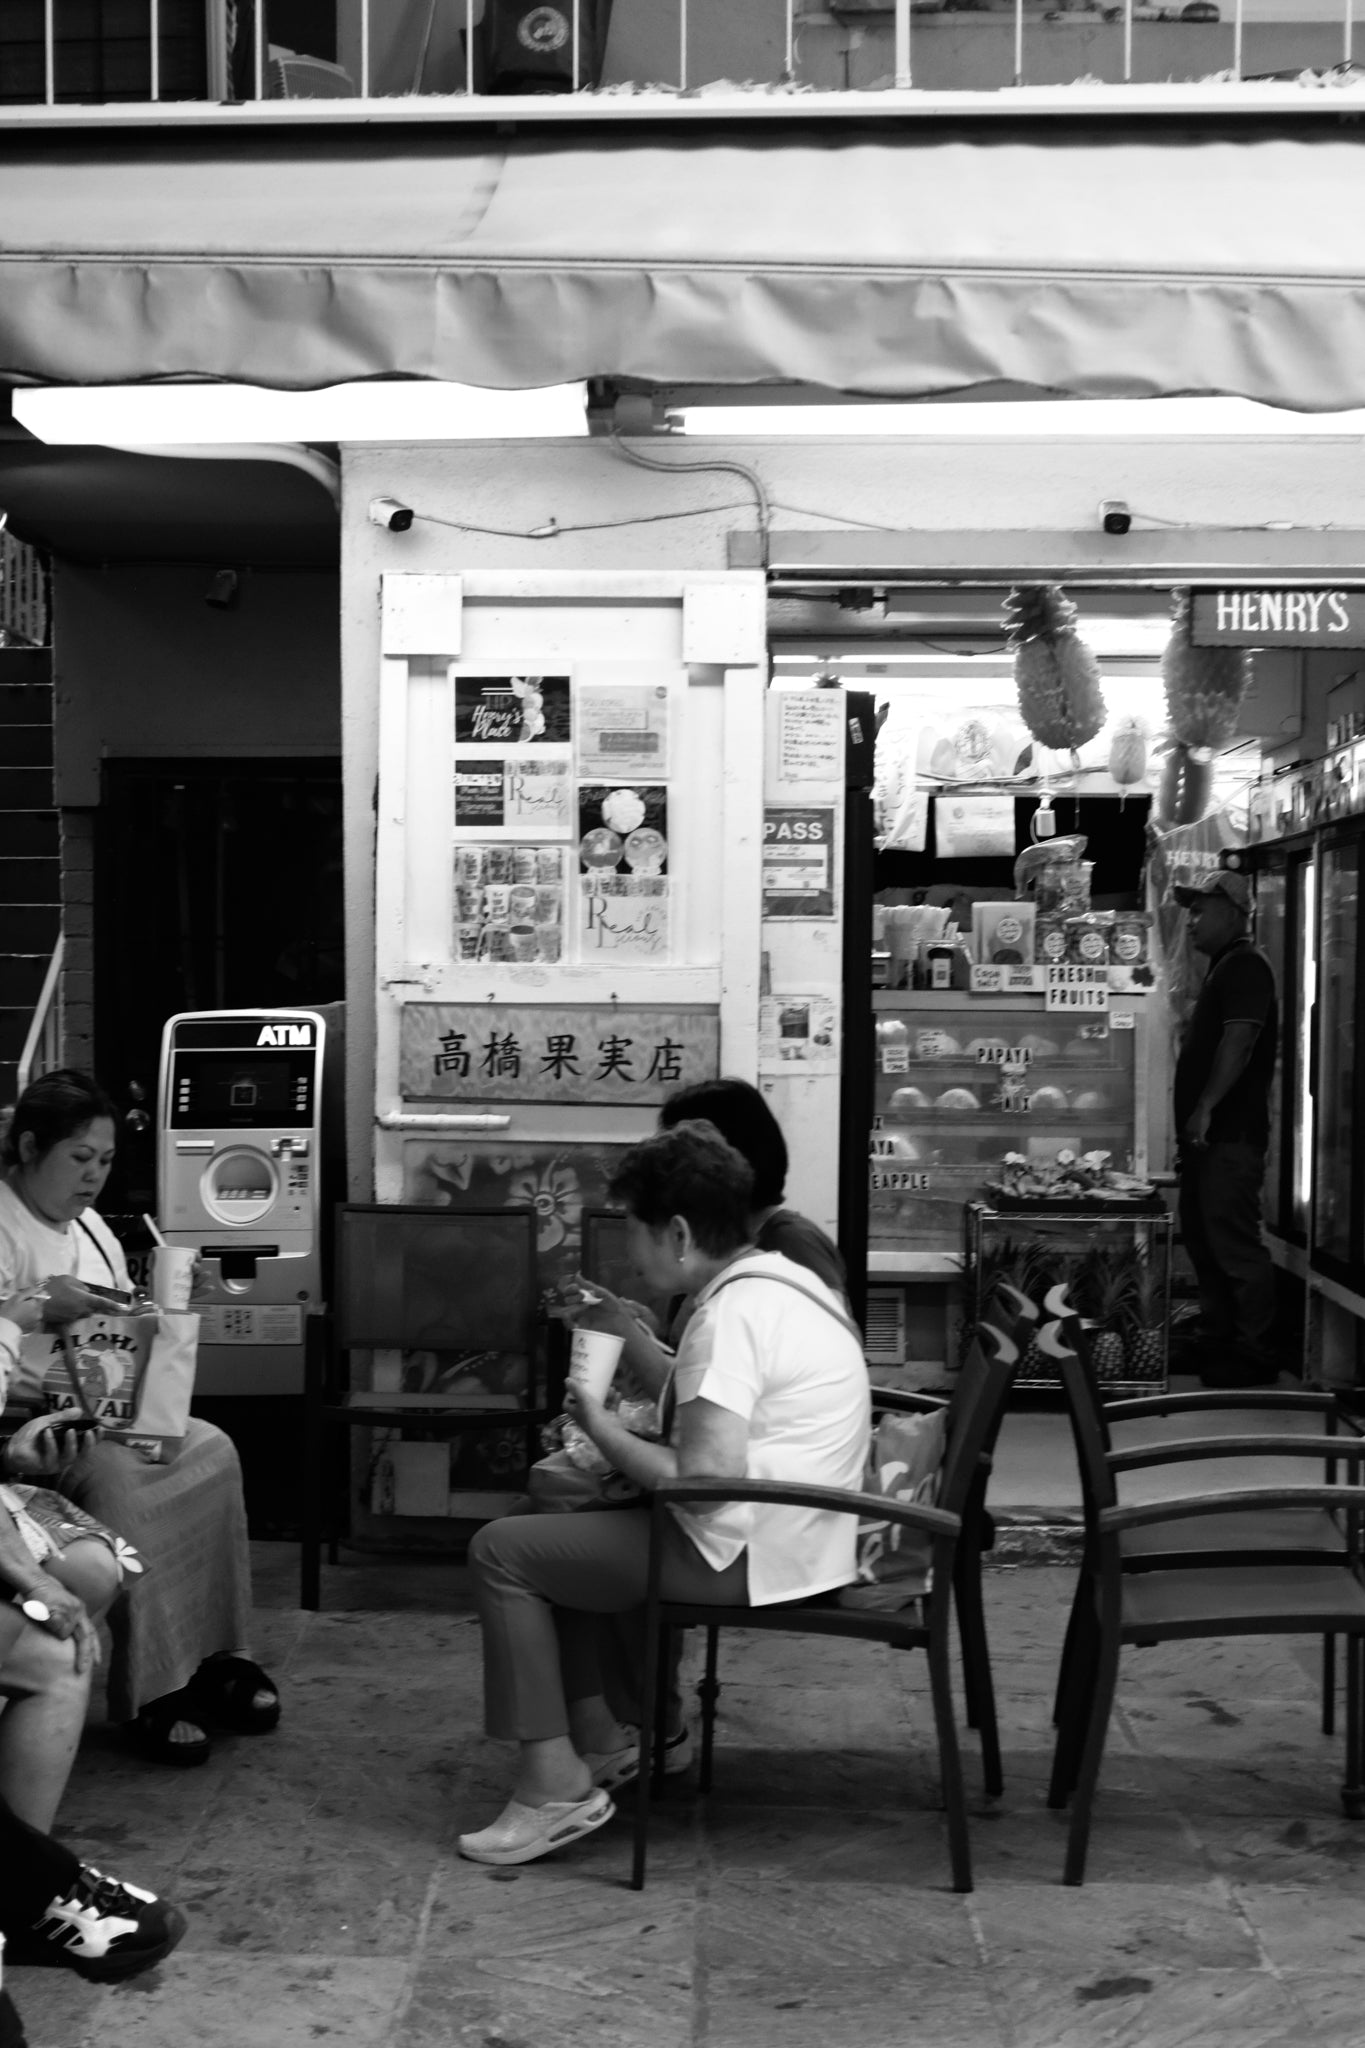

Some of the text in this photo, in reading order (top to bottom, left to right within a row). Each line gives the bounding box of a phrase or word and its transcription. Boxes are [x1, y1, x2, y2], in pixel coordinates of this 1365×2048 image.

[763, 822, 823, 840] PASS
[1050, 967, 1094, 983] FRESH
[1050, 989, 1105, 1005] FRUITS
[256, 1024, 311, 1046] ATM
[432, 1029, 685, 1083] 高橋果実店
[978, 1048, 1030, 1063] PAPAYA
[50, 1332, 138, 1354] ALOH
